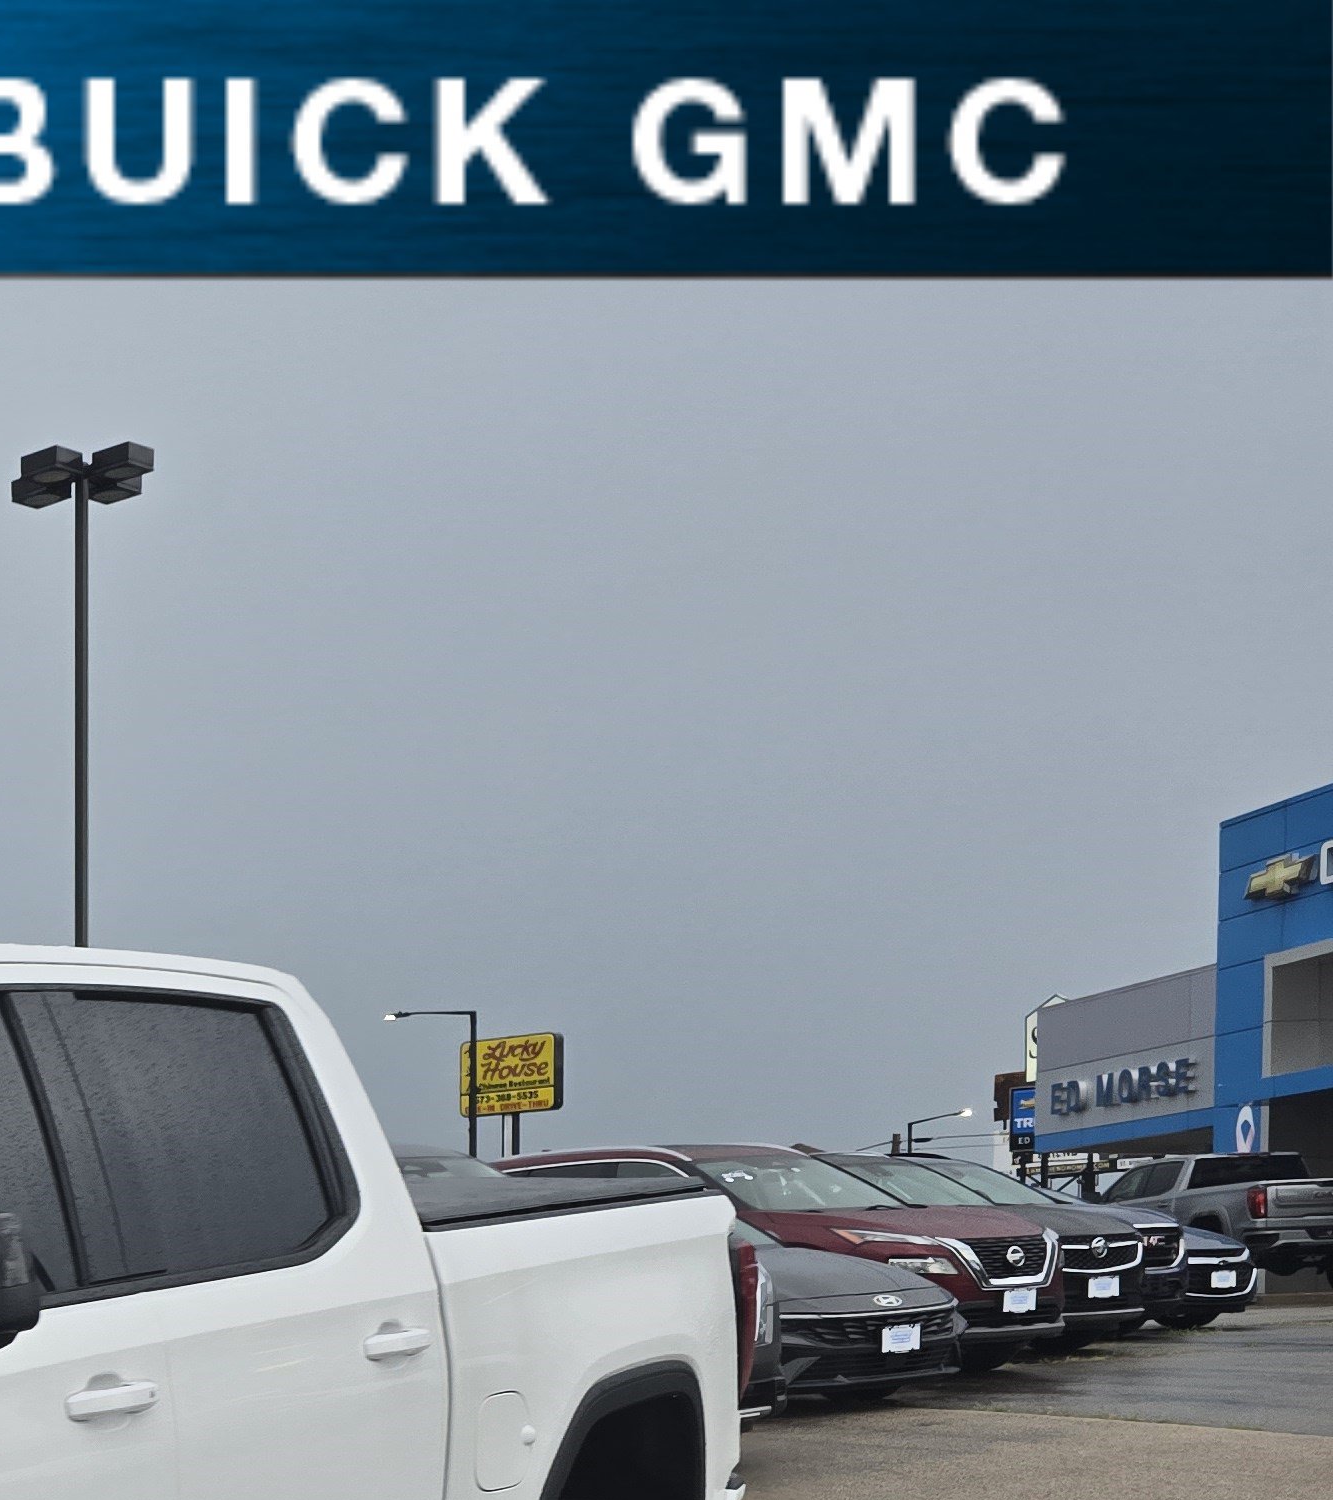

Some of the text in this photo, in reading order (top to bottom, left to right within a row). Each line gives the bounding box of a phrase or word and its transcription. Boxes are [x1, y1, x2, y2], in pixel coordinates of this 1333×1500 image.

[482, 1039, 546, 1061] Lucky
[481, 1061, 549, 1081] House
[1050, 1058, 1191, 1115] ED MORSE
[1018, 1136, 1031, 1145] ED
